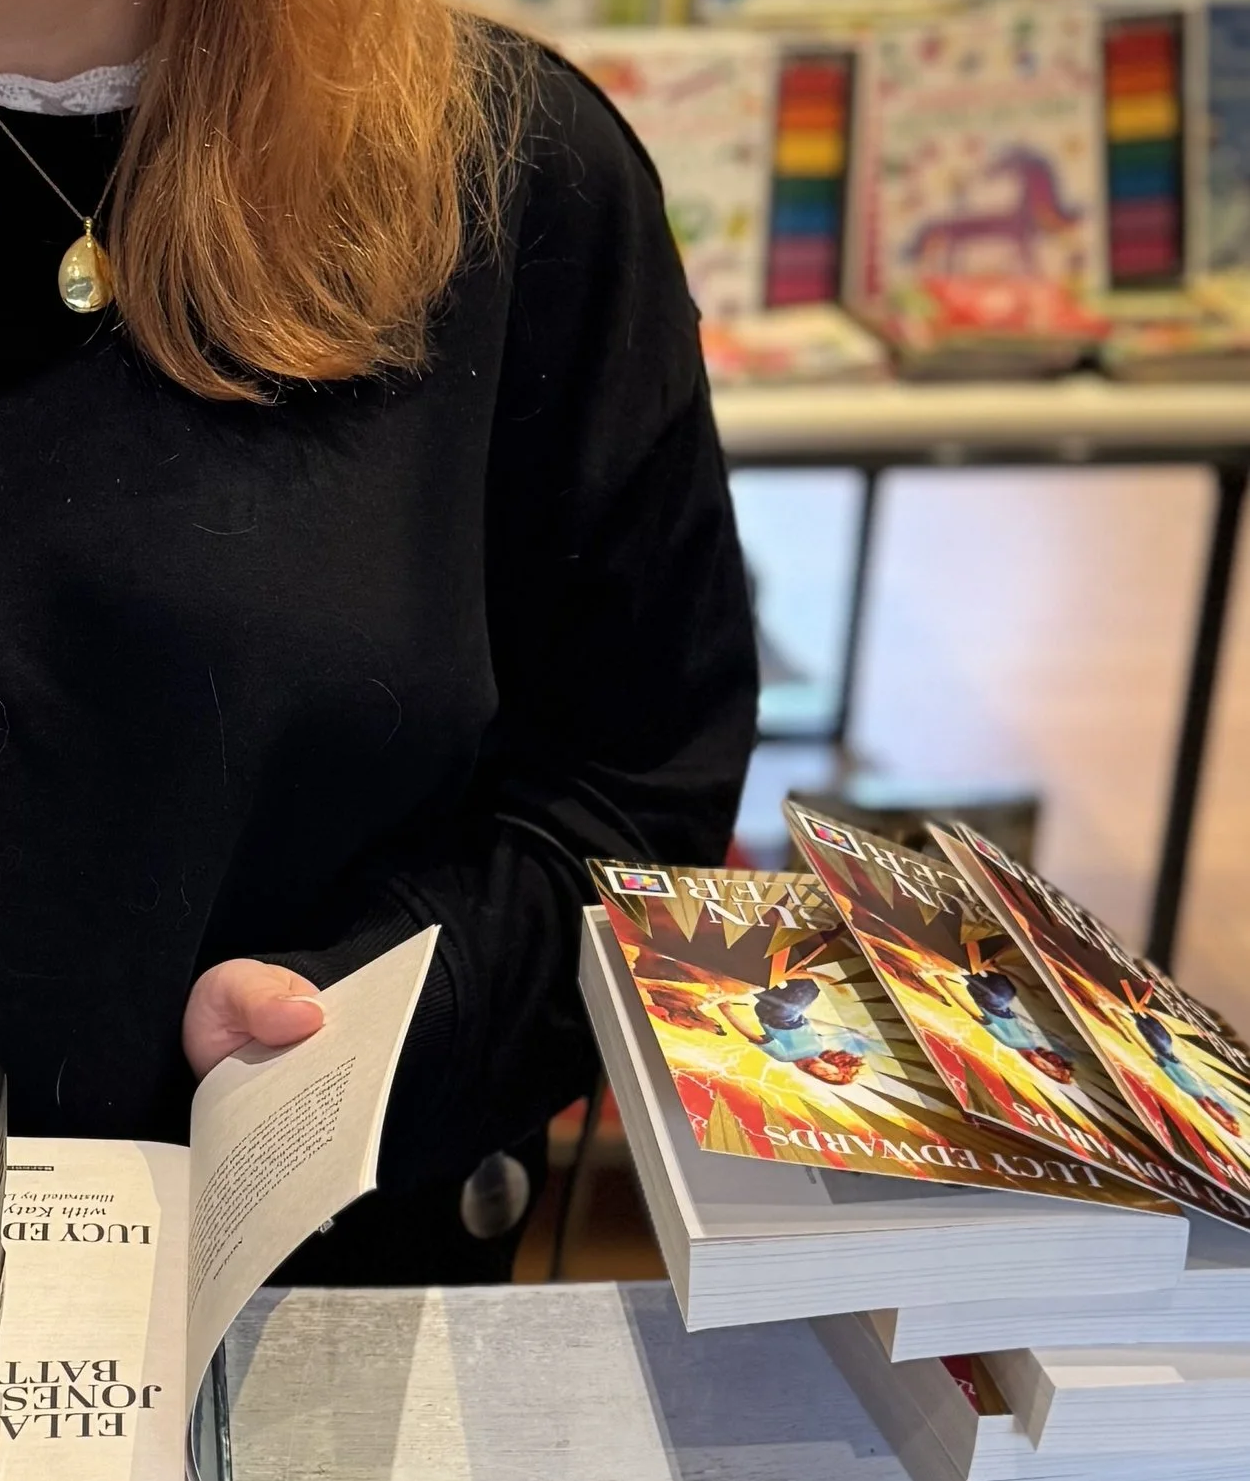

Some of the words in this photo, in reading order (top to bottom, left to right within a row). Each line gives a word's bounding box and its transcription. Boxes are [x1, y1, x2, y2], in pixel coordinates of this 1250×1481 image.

[762, 1124, 981, 1173] EDWARDS
[993, 1159, 1104, 1190] LUCY
[20, 1191, 37, 1201] by
[42, 1194, 114, 1202] Illustrated
[3, 1203, 54, 1218] Katy
[62, 1206, 107, 1218] with
[2, 1222, 51, 1245] ED
[59, 1224, 152, 1245] LUCY
[3, 1385, 162, 1411] JONES
